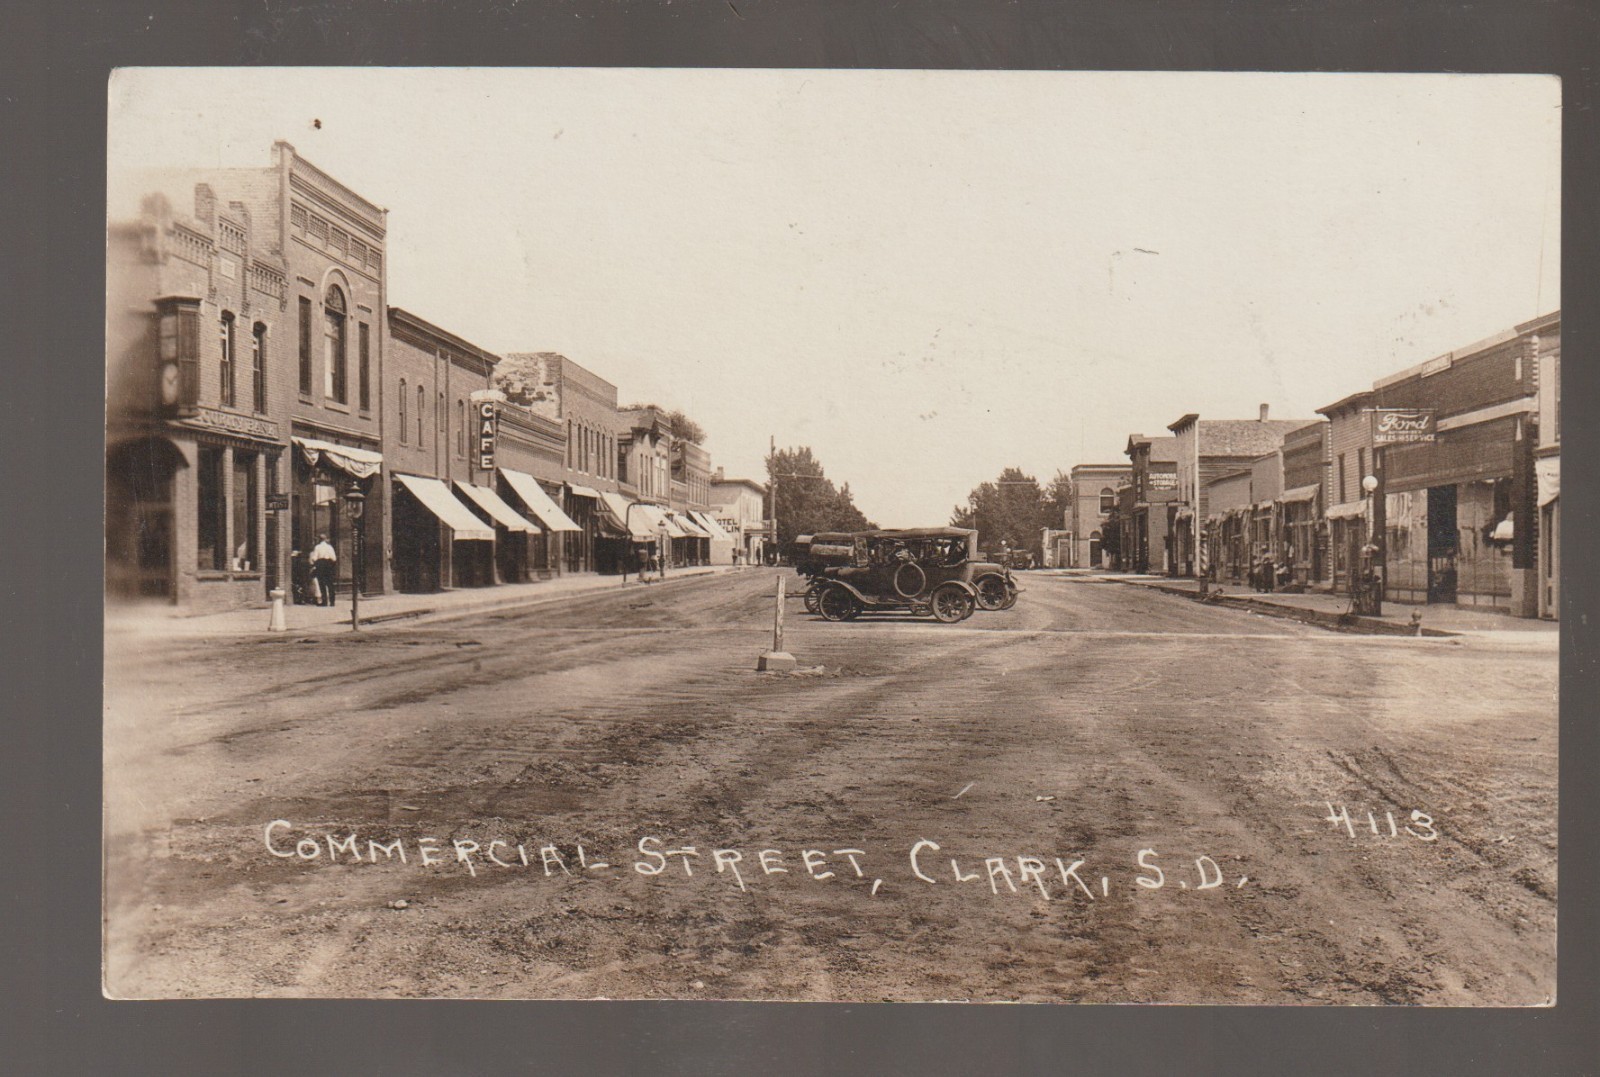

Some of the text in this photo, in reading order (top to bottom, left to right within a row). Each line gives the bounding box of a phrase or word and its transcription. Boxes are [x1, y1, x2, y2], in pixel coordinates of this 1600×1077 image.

[1378, 413, 1430, 431] Ford
[481, 403, 493, 468] CAFE
[1374, 434, 1397, 442] SALES
